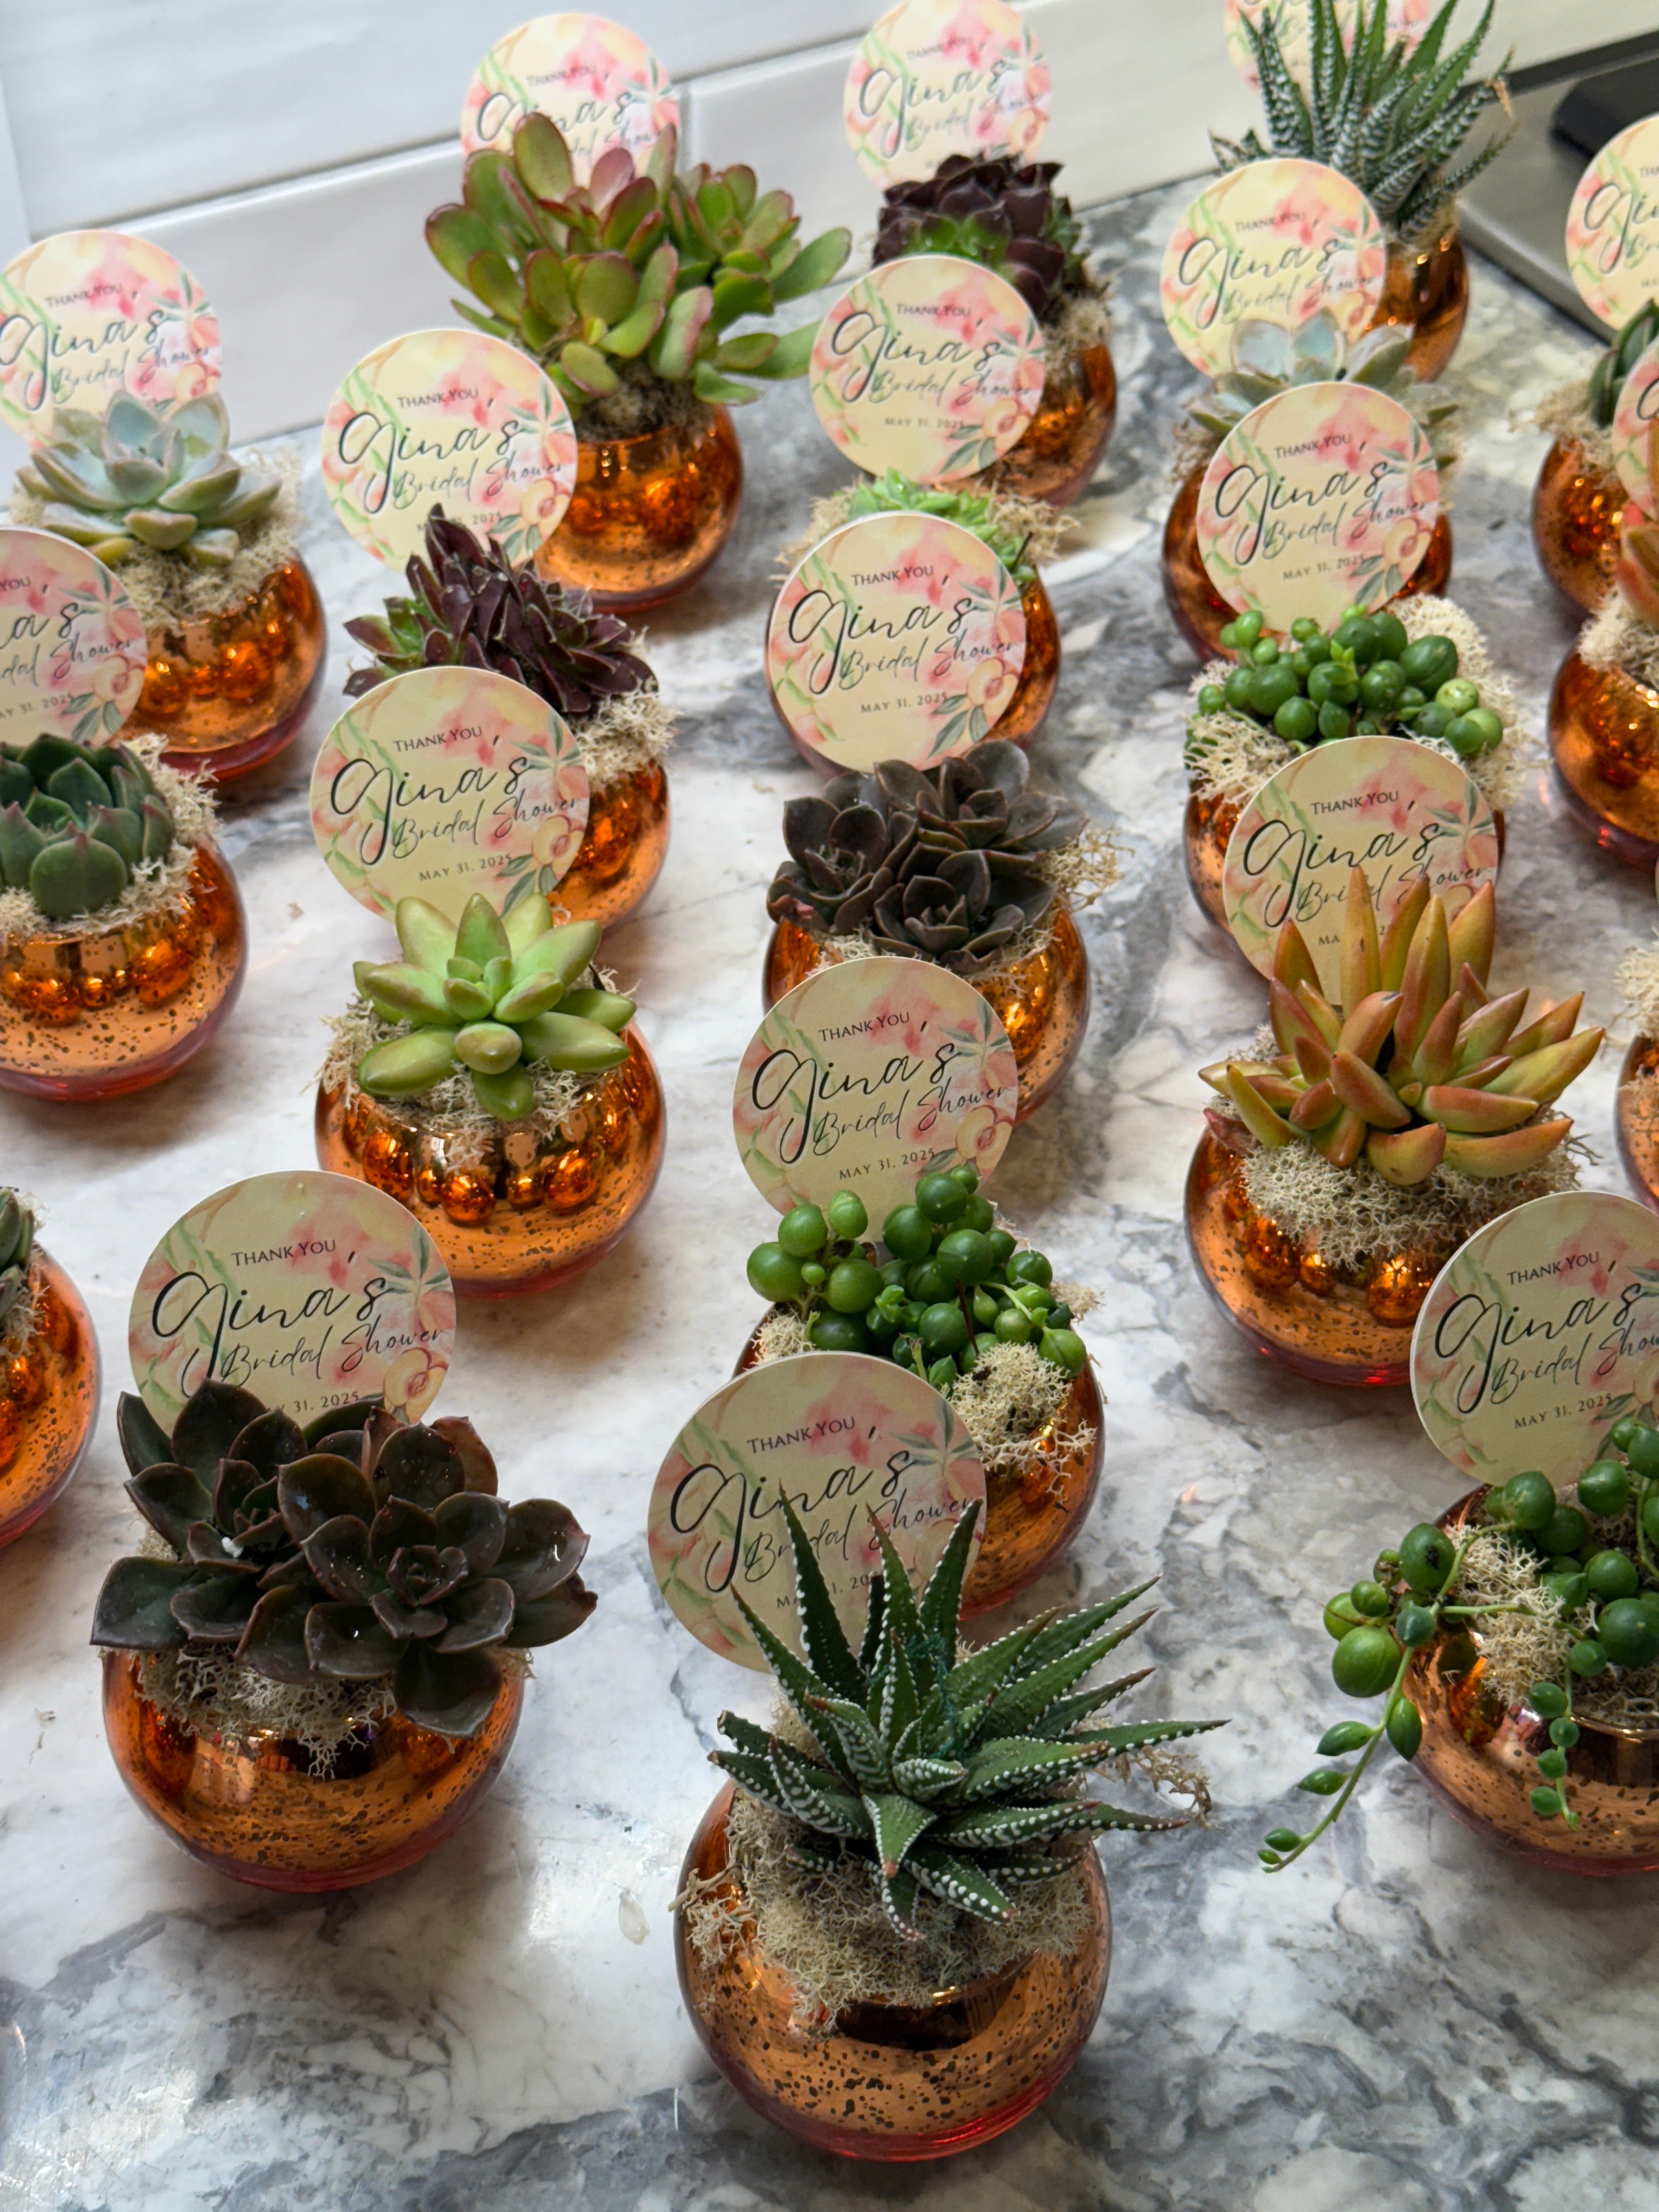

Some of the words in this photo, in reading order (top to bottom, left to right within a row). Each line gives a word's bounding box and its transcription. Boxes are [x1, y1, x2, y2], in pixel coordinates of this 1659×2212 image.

[1178, 219, 1344, 329] Gina's
[1221, 274, 1300, 324] Bridal
[896, 304, 939, 318] THANK
[51, 348, 130, 404] Bridal
[831, 318, 1003, 403] Gina's
[397, 392, 444, 409] THANK
[448, 387, 479, 402] YOU
[868, 369, 956, 407] Bridal
[338, 397, 527, 515] Gina's
[1275, 439, 1319, 460] THANK
[1322, 433, 1352, 449] YOU
[393, 458, 479, 510] Bridal
[485, 449, 563, 497] Shower
[1215, 441, 1402, 567] Gina's
[1262, 502, 1348, 560] Bridal
[1351, 493, 1427, 539] Shower
[851, 571, 900, 587] THANK
[903, 565, 934, 579] YOU
[1283, 566, 1310, 580] MAY
[50, 632, 133, 679] Shower
[788, 574, 980, 695] Gina's
[838, 636, 928, 691] Bridal
[934, 628, 1019, 677] Shower
[860, 701, 890, 714] MAY
[917, 691, 948, 706] 2025
[393, 733, 447, 753] THANK
[449, 726, 483, 743] YOU
[330, 735, 538, 866] Gina's
[392, 798, 486, 859] Bridal
[493, 789, 584, 839] Shower
[1310, 797, 1364, 816] THANK
[1366, 790, 1400, 806] YOU
[419, 867, 450, 882] MAY
[479, 853, 513, 869] 2025
[1243, 800, 1449, 928] Gina's
[1318, 934, 1340, 946] MA
[818, 1020, 873, 1042] THANK
[876, 1011, 910, 1030] YOU
[752, 1020, 966, 1165] Gina's
[812, 1089, 910, 1156] Bridal
[917, 1076, 1013, 1132] Shower
[839, 1164, 871, 1181] MAY
[901, 1147, 936, 1165] 2025
[231, 1246, 294, 1267] THANK
[297, 1239, 336, 1256] YOU
[1506, 1261, 1562, 1286] THANK
[1565, 1250, 1601, 1269] YOU
[152, 1250, 395, 1399] Gina's
[221, 1325, 332, 1387] Bridal
[341, 1314, 444, 1373] Shower
[1434, 1260, 1651, 1414] Gina's
[1489, 1331, 1593, 1405] Bridal
[320, 1391, 359, 1409] 2025
[1514, 1410, 1547, 1430] MAY
[1577, 1393, 1612, 1413] 2025
[746, 1427, 812, 1454] THANK
[816, 1416, 856, 1438] YOU
[670, 1426, 923, 1593] Gina's
[744, 1504, 857, 1583] Brdal
